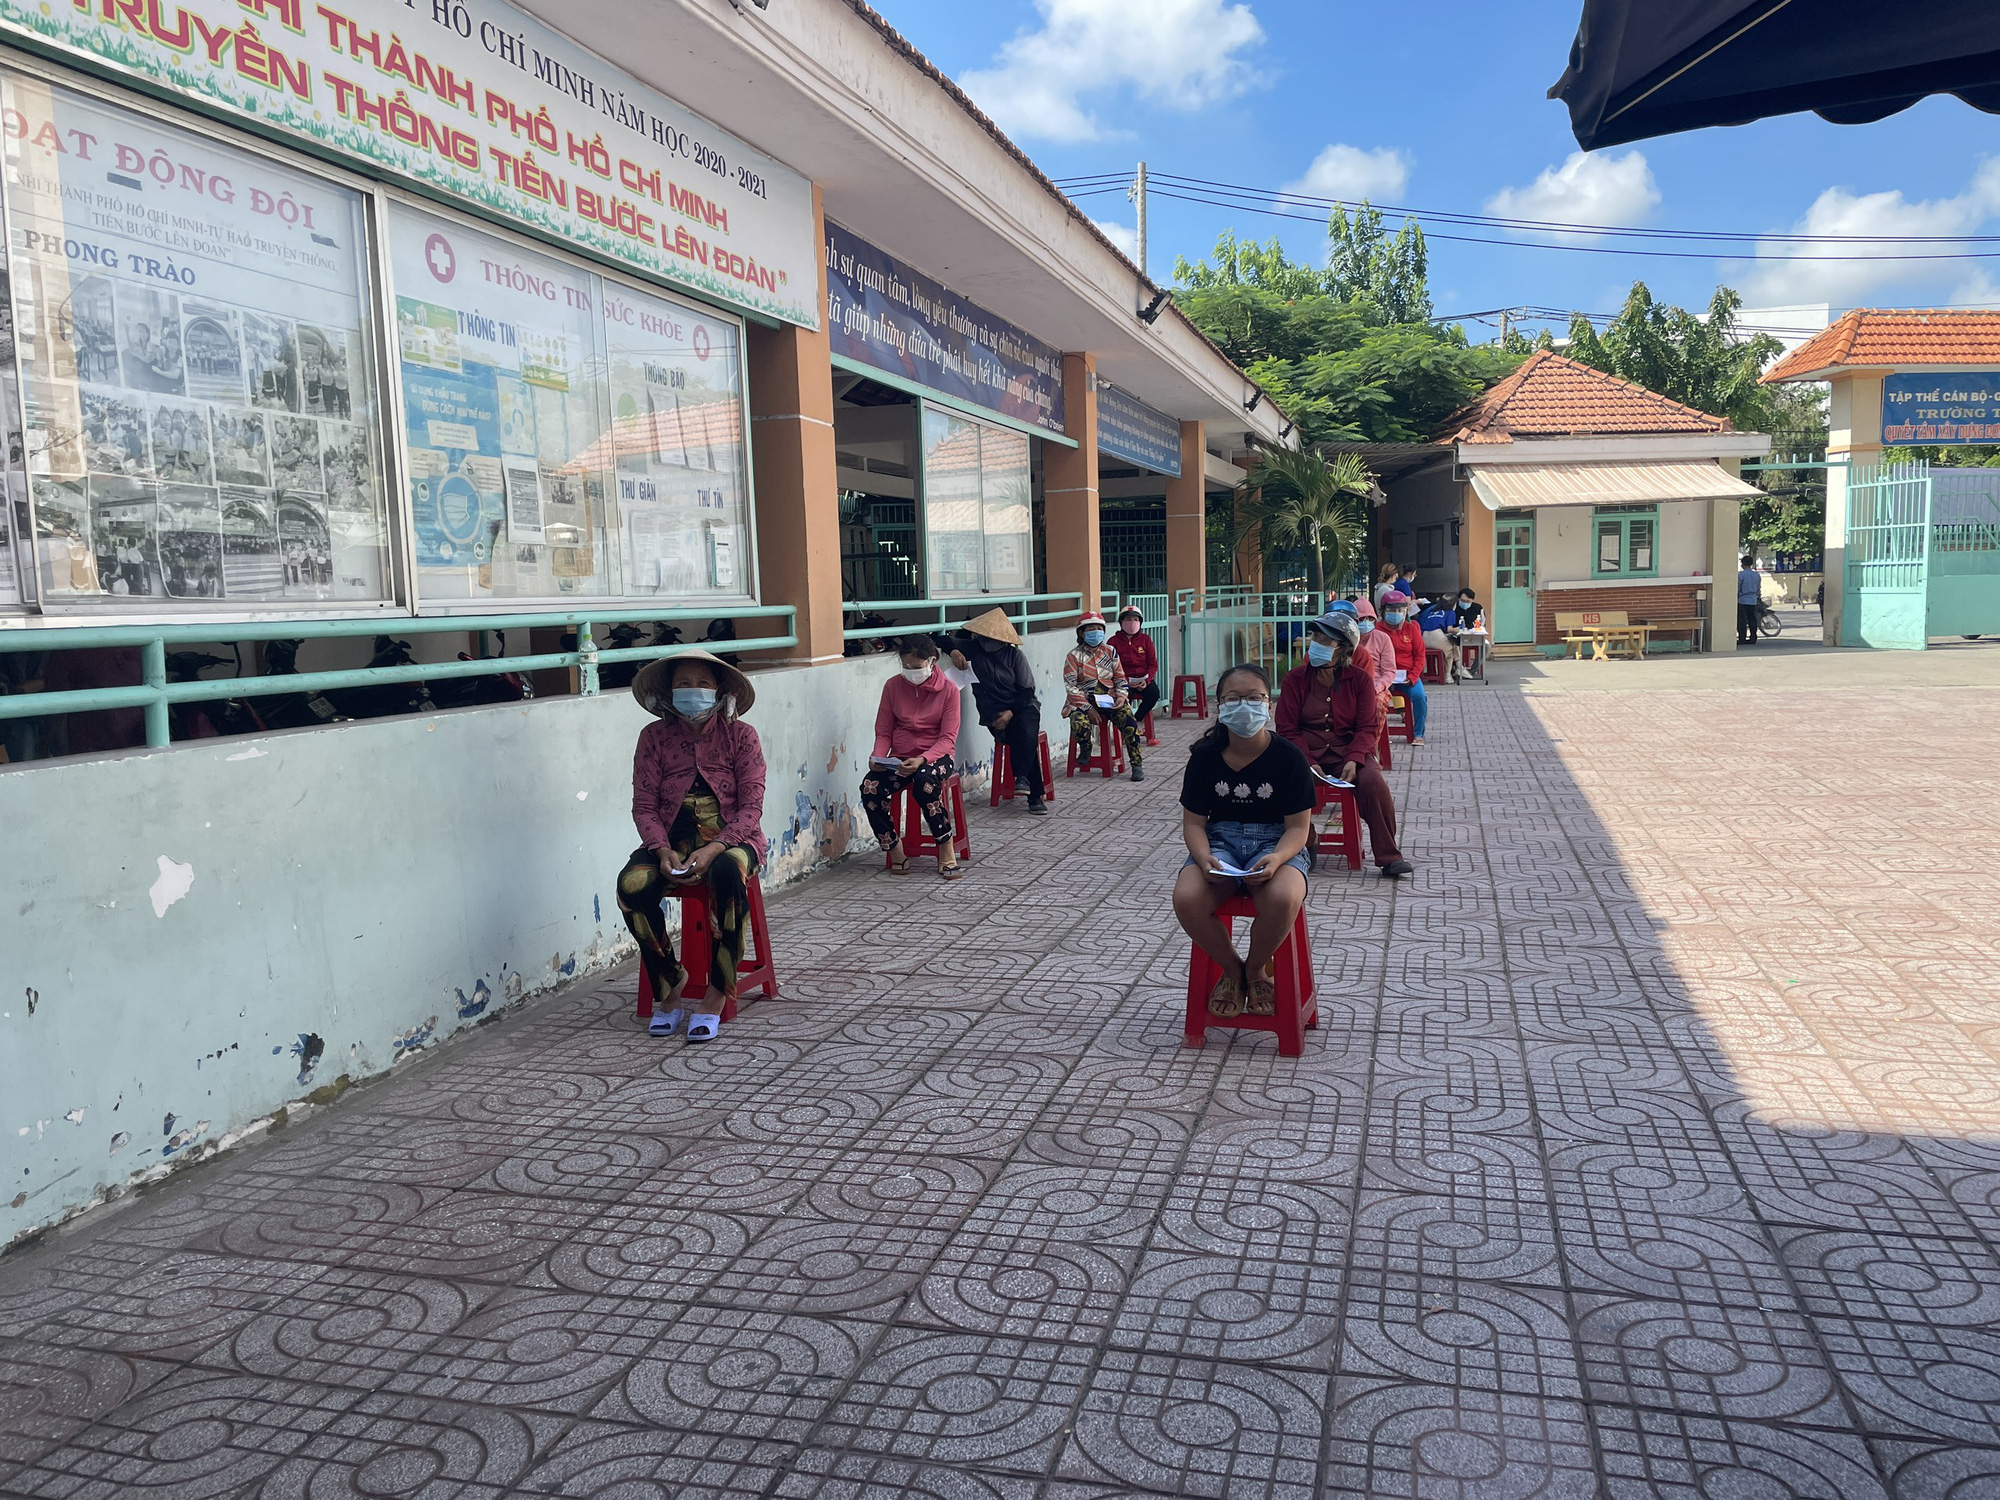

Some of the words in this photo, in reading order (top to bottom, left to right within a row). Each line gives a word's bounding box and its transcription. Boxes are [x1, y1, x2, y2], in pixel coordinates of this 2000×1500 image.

[72, 0, 310, 100] RUYỀN
[323, 72, 480, 169] THỐNG
[489, 147, 567, 207] TIẾN
[575, 188, 655, 244] BƯỚC
[661, 223, 708, 266] LÊN
[316, 5, 475, 113] THÀNH
[485, 90, 558, 152] PHỐ
[566, 133, 611, 178] HỒ
[619, 159, 663, 203] CHÍ
[669, 183, 728, 232] MINH
[480, 21, 527, 72] CHÍ
[532, 49, 596, 109] MINH
[600, 87, 647, 136] NĂM
[650, 115, 690, 158] HỌC
[694, 141, 727, 178] 2020
[738, 166, 768, 200] 2021
[114, 143, 236, 205] ĐỘNG
[249, 187, 316, 230] ĐỘI
[24, 229, 119, 268] PHONG
[128, 254, 196, 286] TRÀO
[479, 259, 557, 301] THÔNG
[562, 286, 593, 311] TIN
[640, 312, 684, 342] KHỎE
[498, 322, 516, 347] TIN
[840, 254, 854, 287] sự
[857, 263, 885, 294] quan
[912, 282, 931, 323] lòng
[932, 299, 947, 327] yêu
[949, 305, 978, 346] thương
[643, 359, 668, 386] THÔNG
[670, 366, 685, 390] BÁO
[843, 302, 870, 342] giúp
[873, 313, 906, 357] những
[908, 326, 926, 359] đứa
[928, 338, 942, 364] trẻ
[942, 344, 961, 374] phát
[963, 351, 977, 385] huy
[978, 358, 991, 385] hết
[1884, 417, 1916, 442] QUYẾT
[1916, 420, 1936, 439] TÂM
[1937, 420, 1958, 439] XÂY
[1958, 421, 1984, 443] DỰNG
[1888, 390, 1912, 405] TẬP
[1915, 388, 1940, 402] THỂ
[1942, 390, 1967, 402] CÁN
[1915, 405, 1987, 419] TRƯỜNG
[1584, 614, 1600, 623] HS
